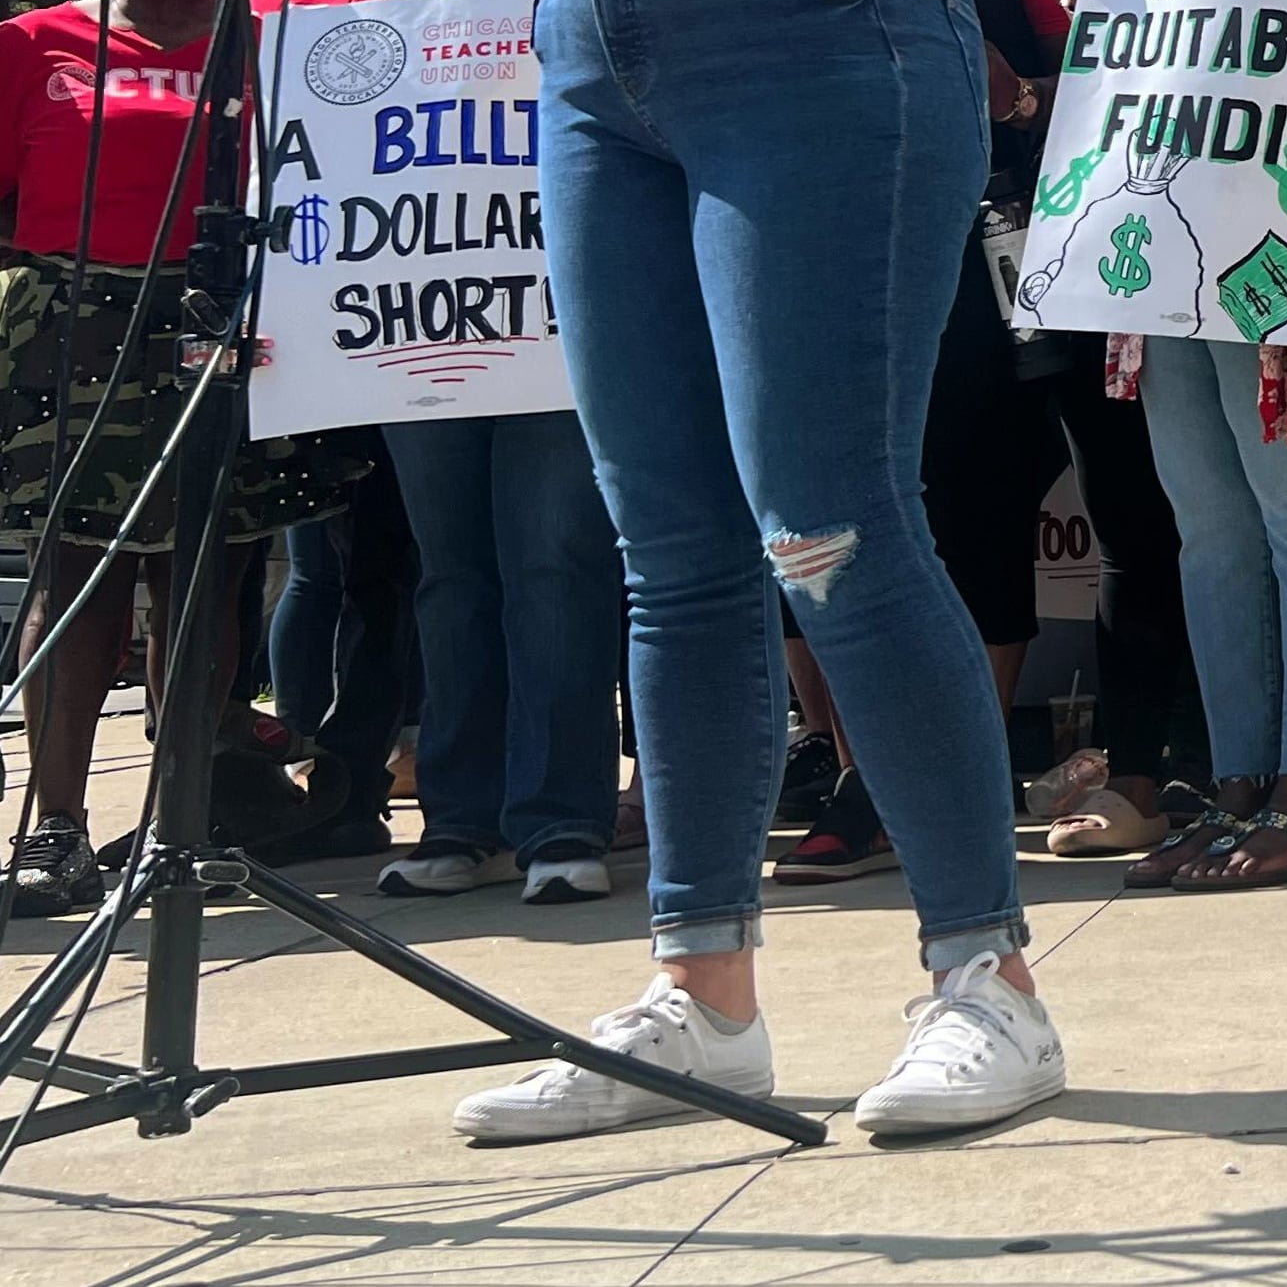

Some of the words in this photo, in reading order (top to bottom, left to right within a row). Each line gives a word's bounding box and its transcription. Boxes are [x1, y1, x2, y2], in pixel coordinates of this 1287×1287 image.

[104, 66, 203, 101] CTU
[420, 62, 516, 85] UNION
[342, 89, 378, 102] LOCAL
[273, 118, 322, 183] A
[331, 275, 559, 351] SHORT!
